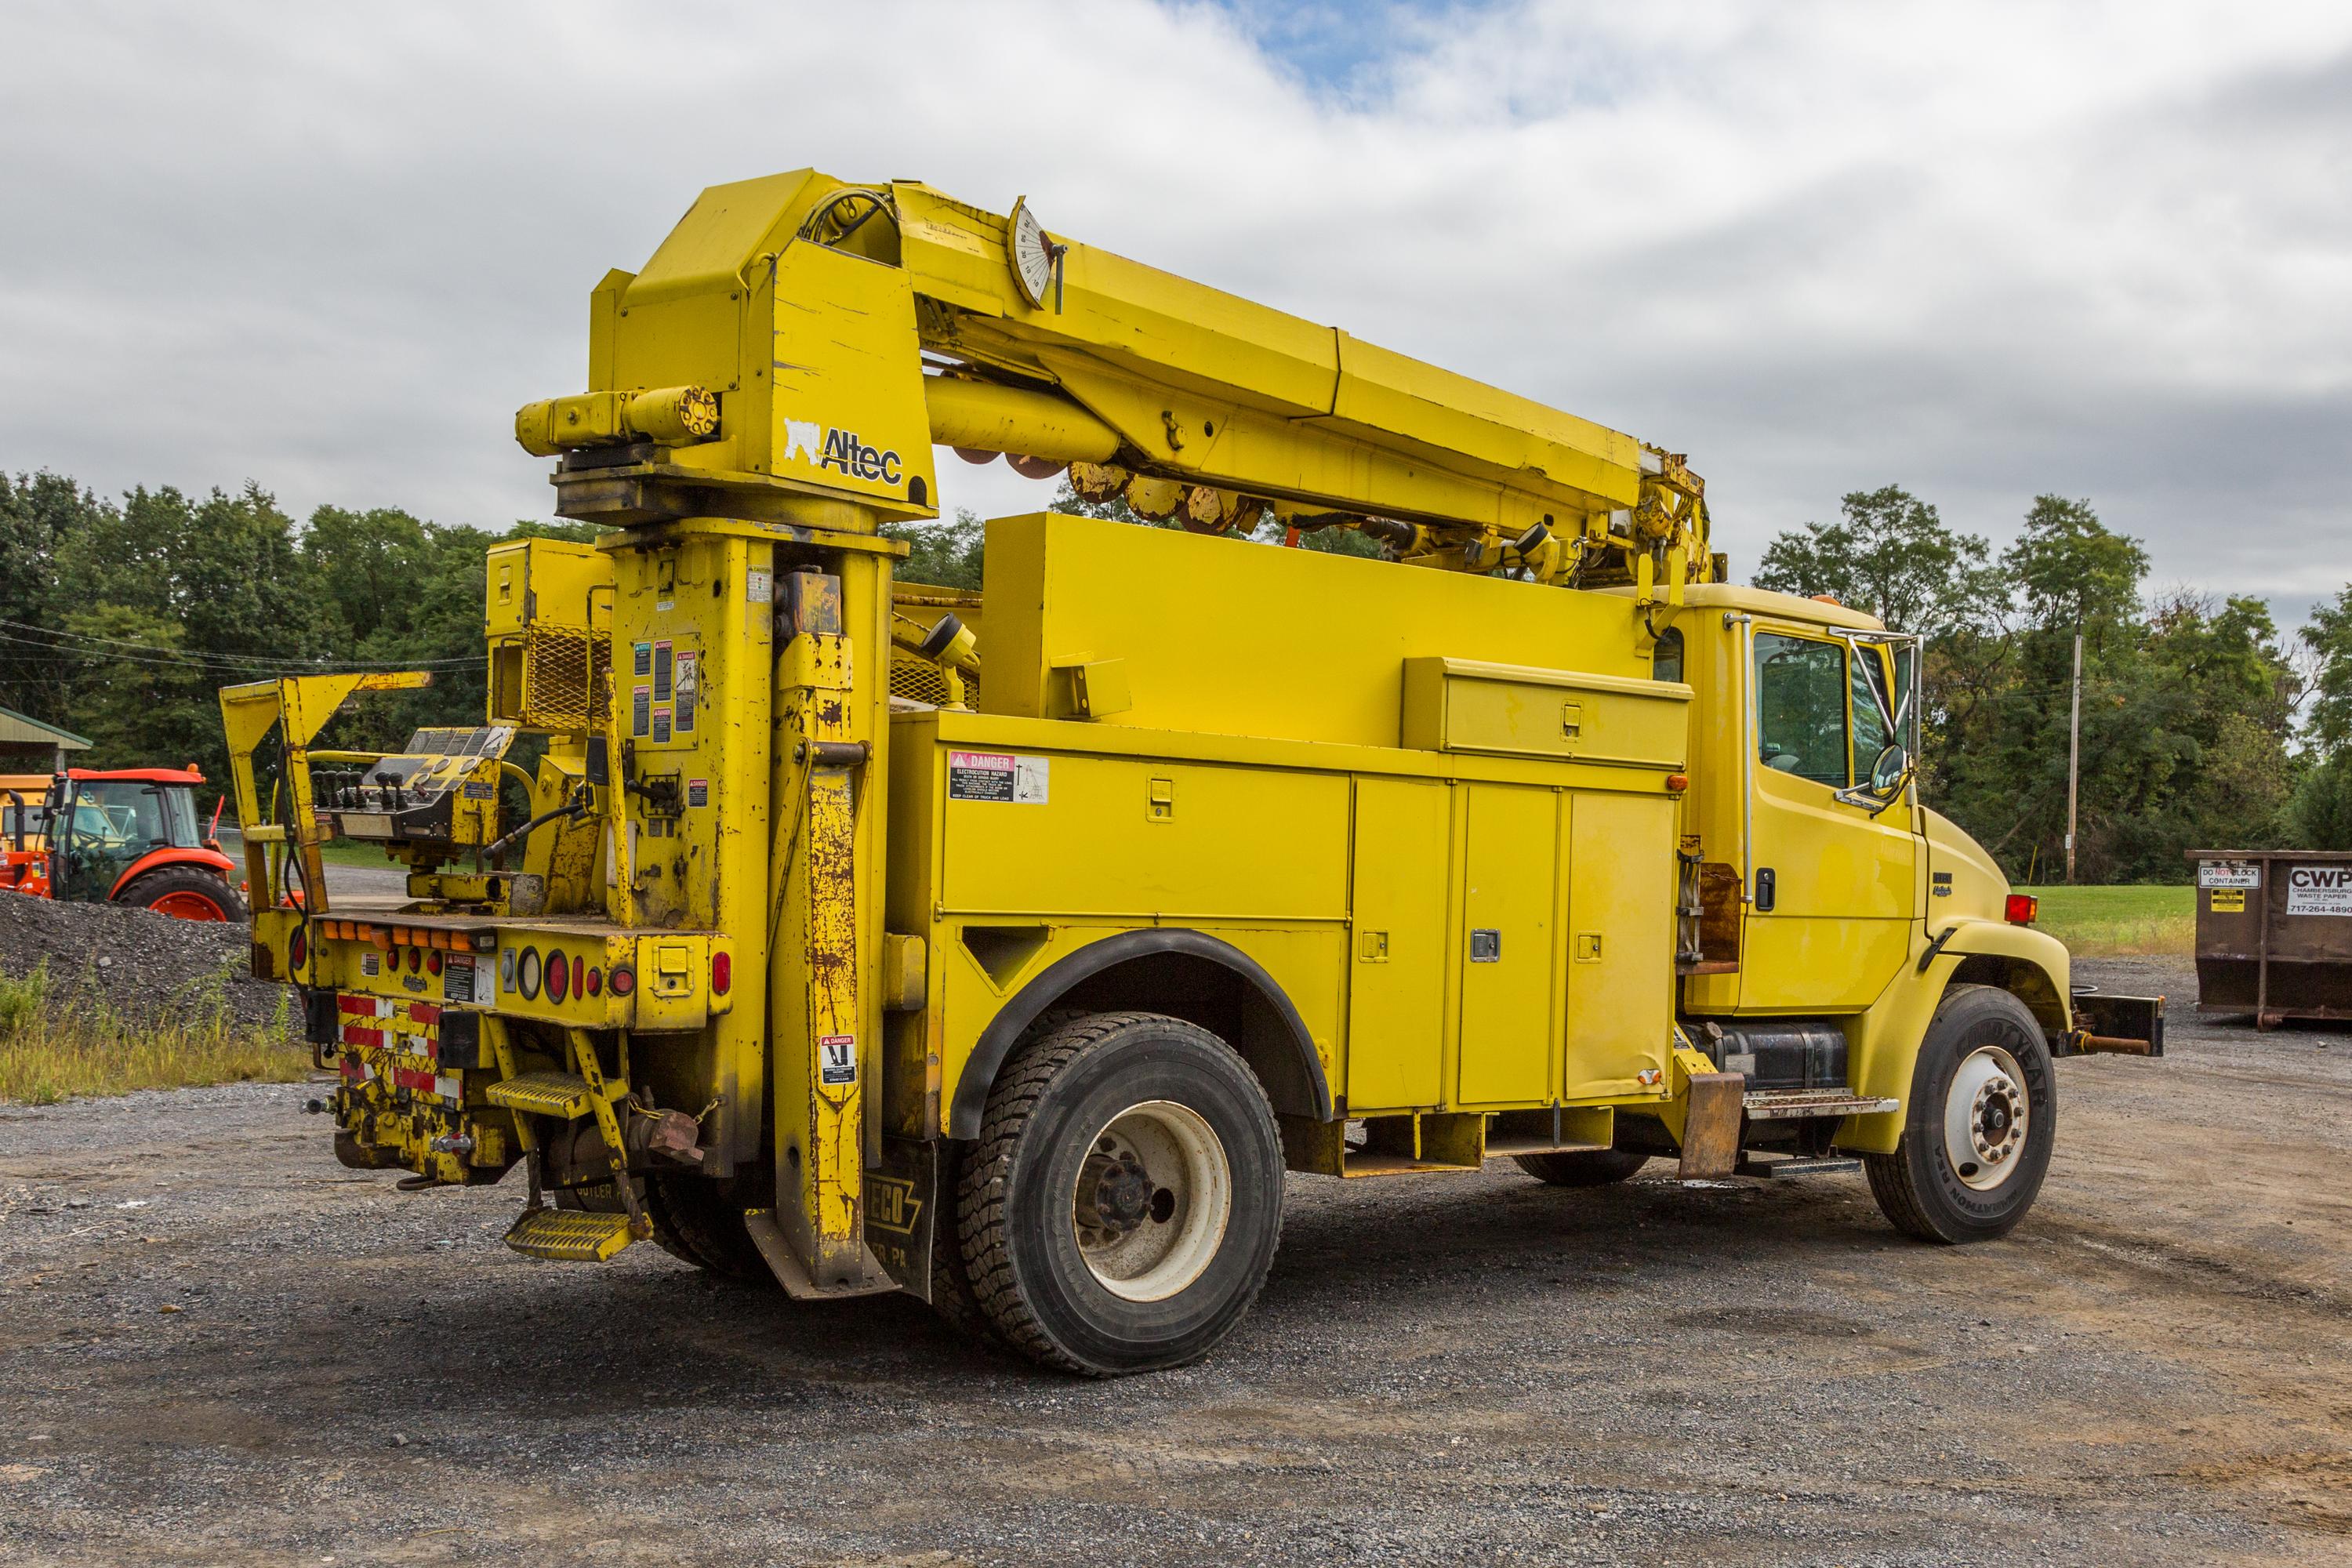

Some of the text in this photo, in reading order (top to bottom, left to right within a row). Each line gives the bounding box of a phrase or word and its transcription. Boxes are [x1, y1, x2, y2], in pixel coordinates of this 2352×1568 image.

[1021, 250, 1027, 259] 30
[1025, 265, 1031, 274] 10
[820, 427, 902, 485] Altec
[971, 755, 1009, 769] DANGER
[2215, 866, 2230, 876] NOT
[2291, 869, 2352, 888] CWP
[2290, 905, 2352, 913] 717-264-4890
